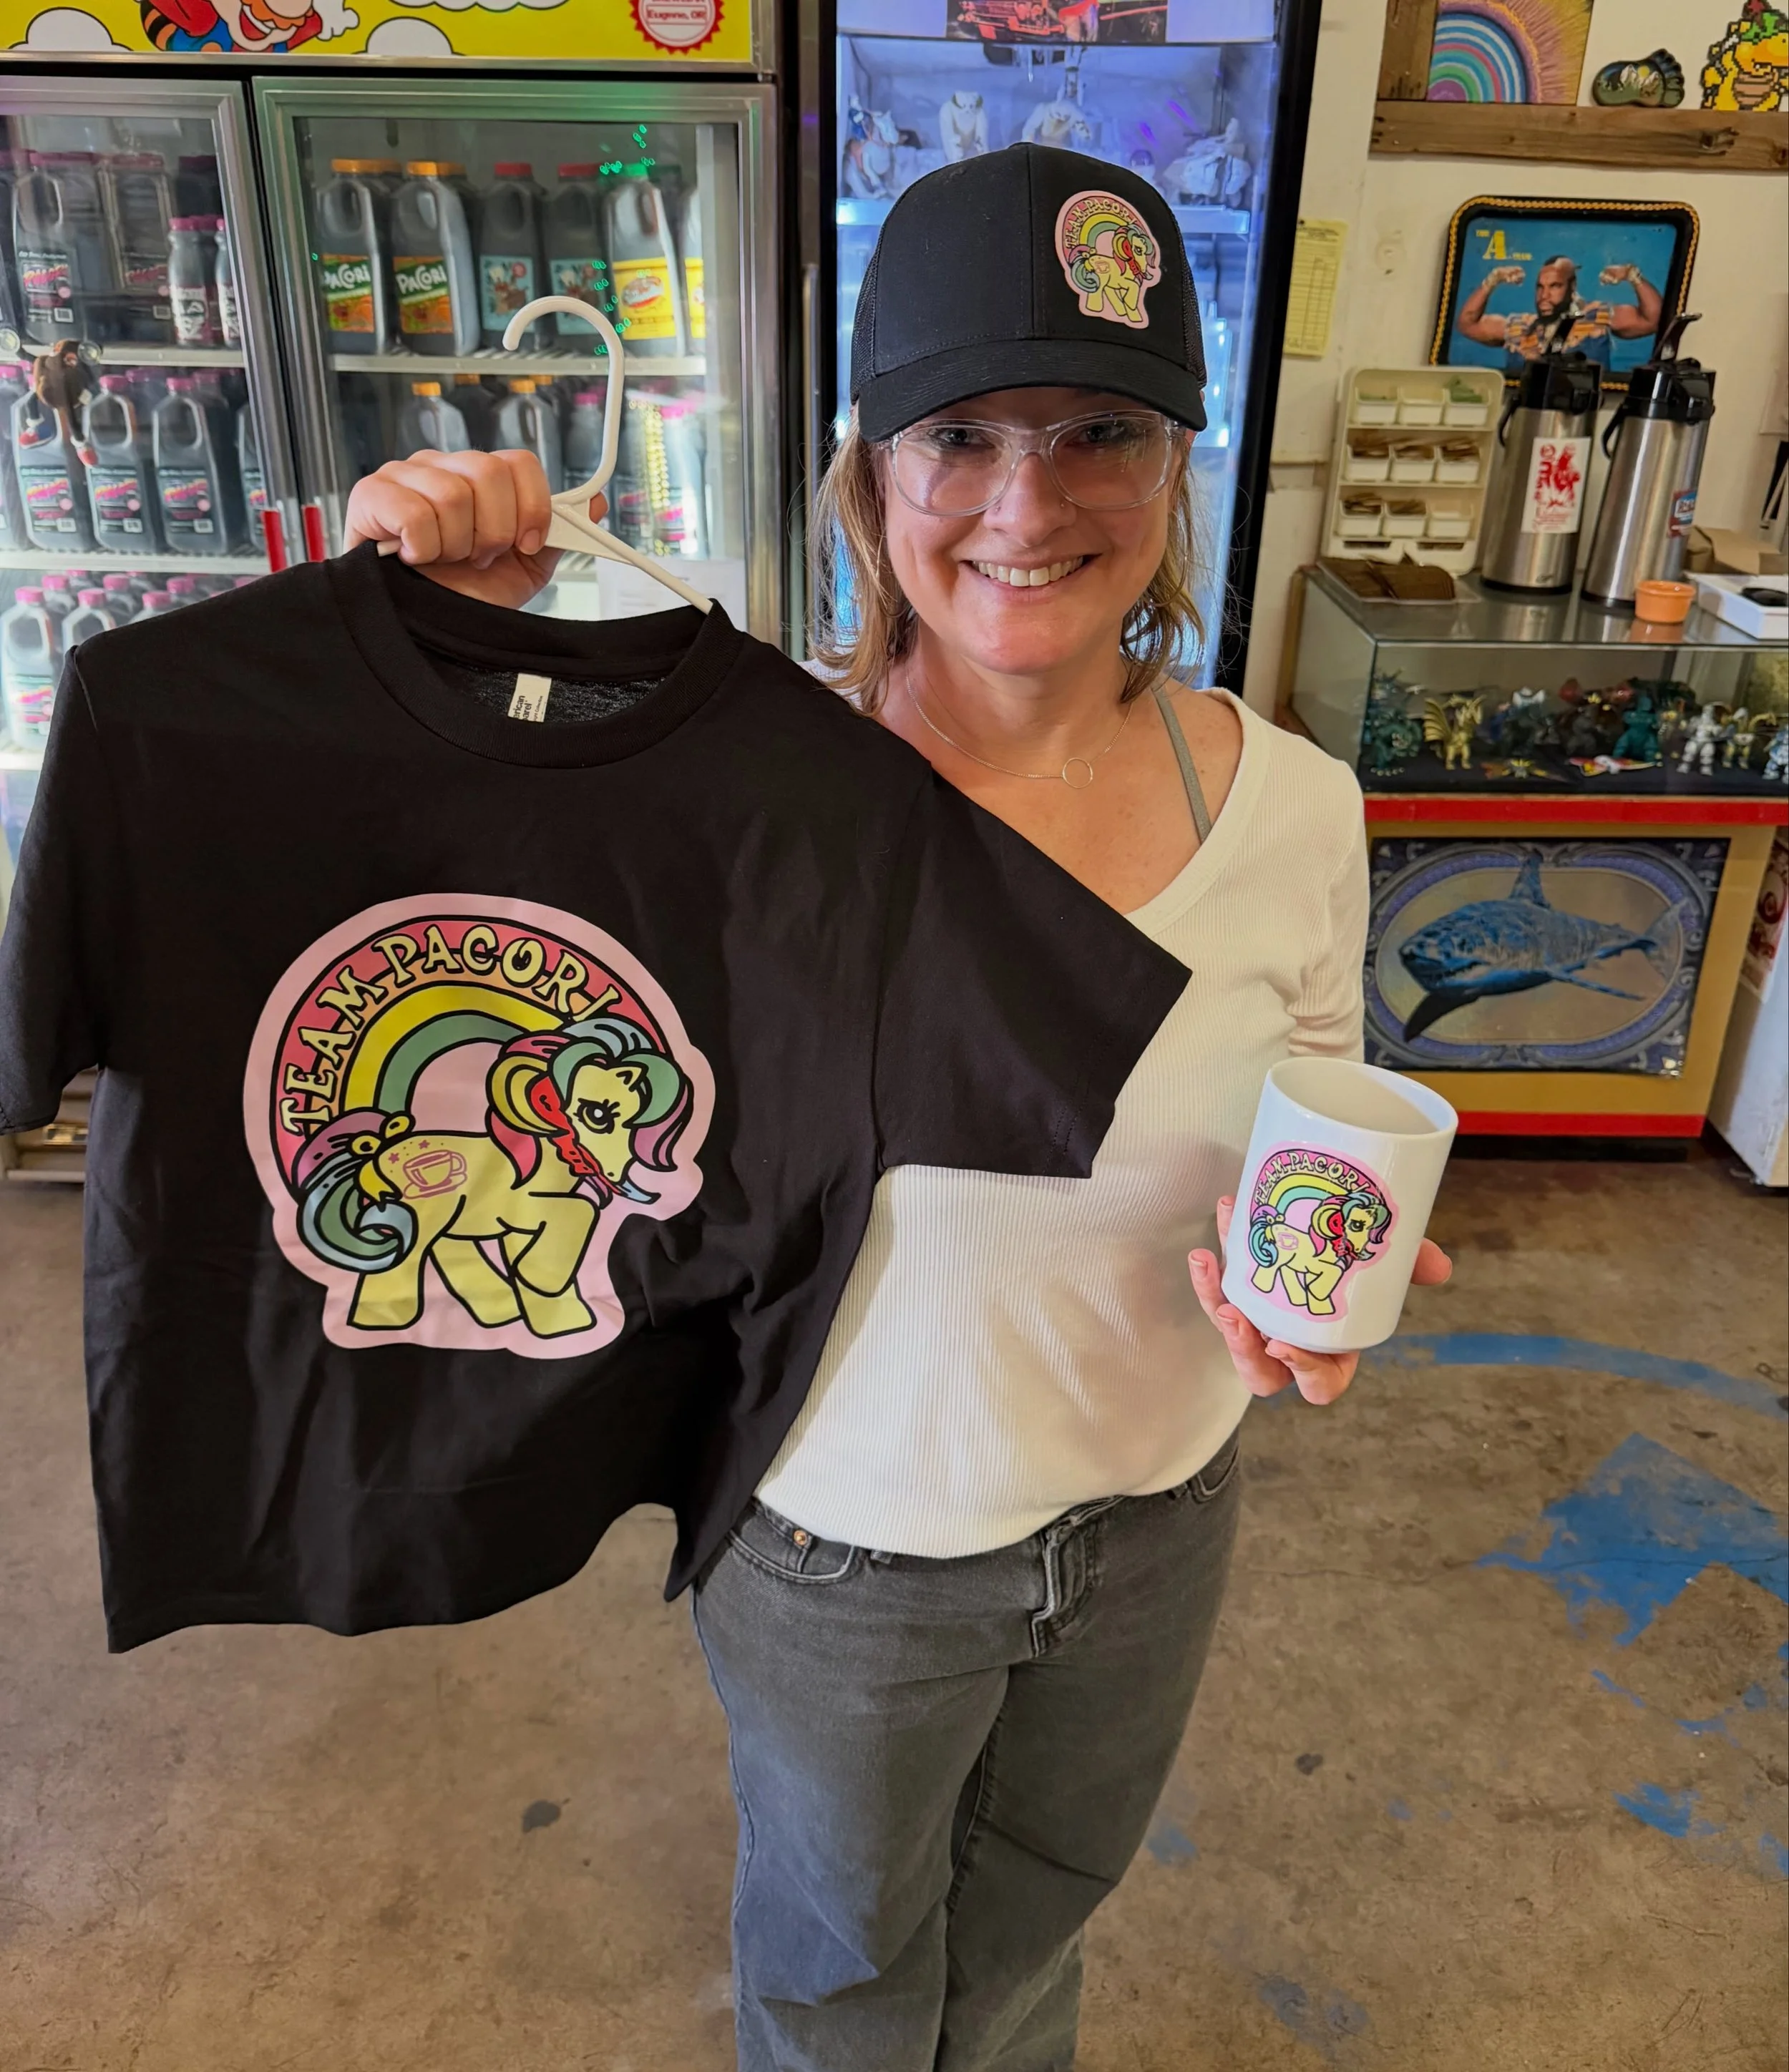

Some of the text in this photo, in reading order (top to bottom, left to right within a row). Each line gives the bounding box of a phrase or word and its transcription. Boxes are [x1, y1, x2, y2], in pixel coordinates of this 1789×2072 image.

[646, 10, 688, 20] Eugene,
[1065, 198, 1138, 248] TEAM PACORI
[396, 265, 448, 294] PACORI
[280, 924, 622, 1135] TEAM PACORI
[1254, 1150, 1371, 1206] TEAM PACORI
